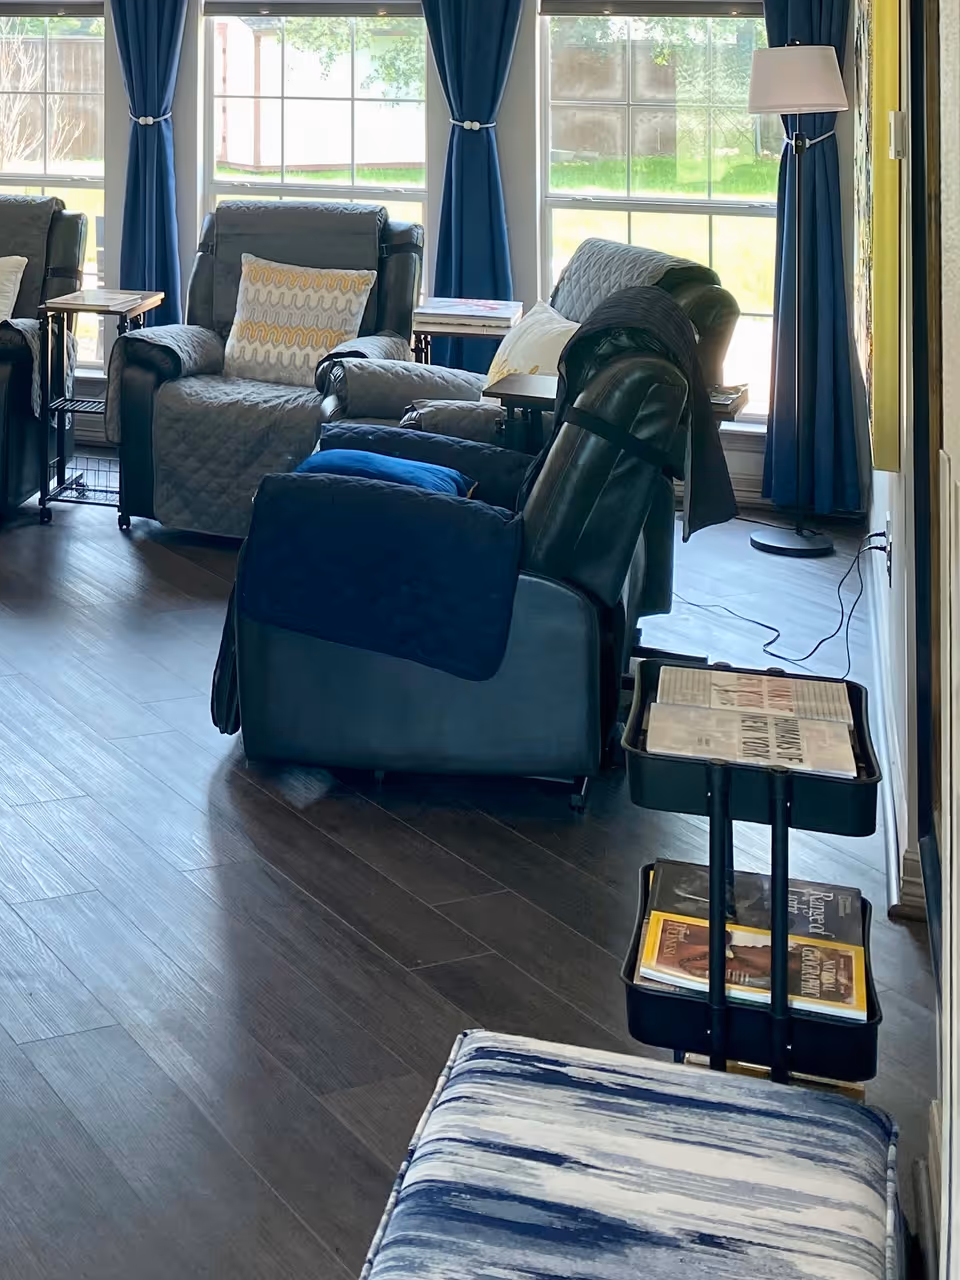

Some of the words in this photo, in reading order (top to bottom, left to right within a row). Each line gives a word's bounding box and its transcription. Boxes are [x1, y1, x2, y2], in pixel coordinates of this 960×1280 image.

[741, 713, 768, 734] NEW
[774, 715, 801, 751] HUMANS
[742, 736, 771, 760] YORK
[776, 751, 803, 763] OF
[803, 889, 834, 923] Range
[809, 923, 836, 939] of
[801, 947, 820, 998] GEOGRAPHIC
[822, 960, 837, 992] NATIONAL
